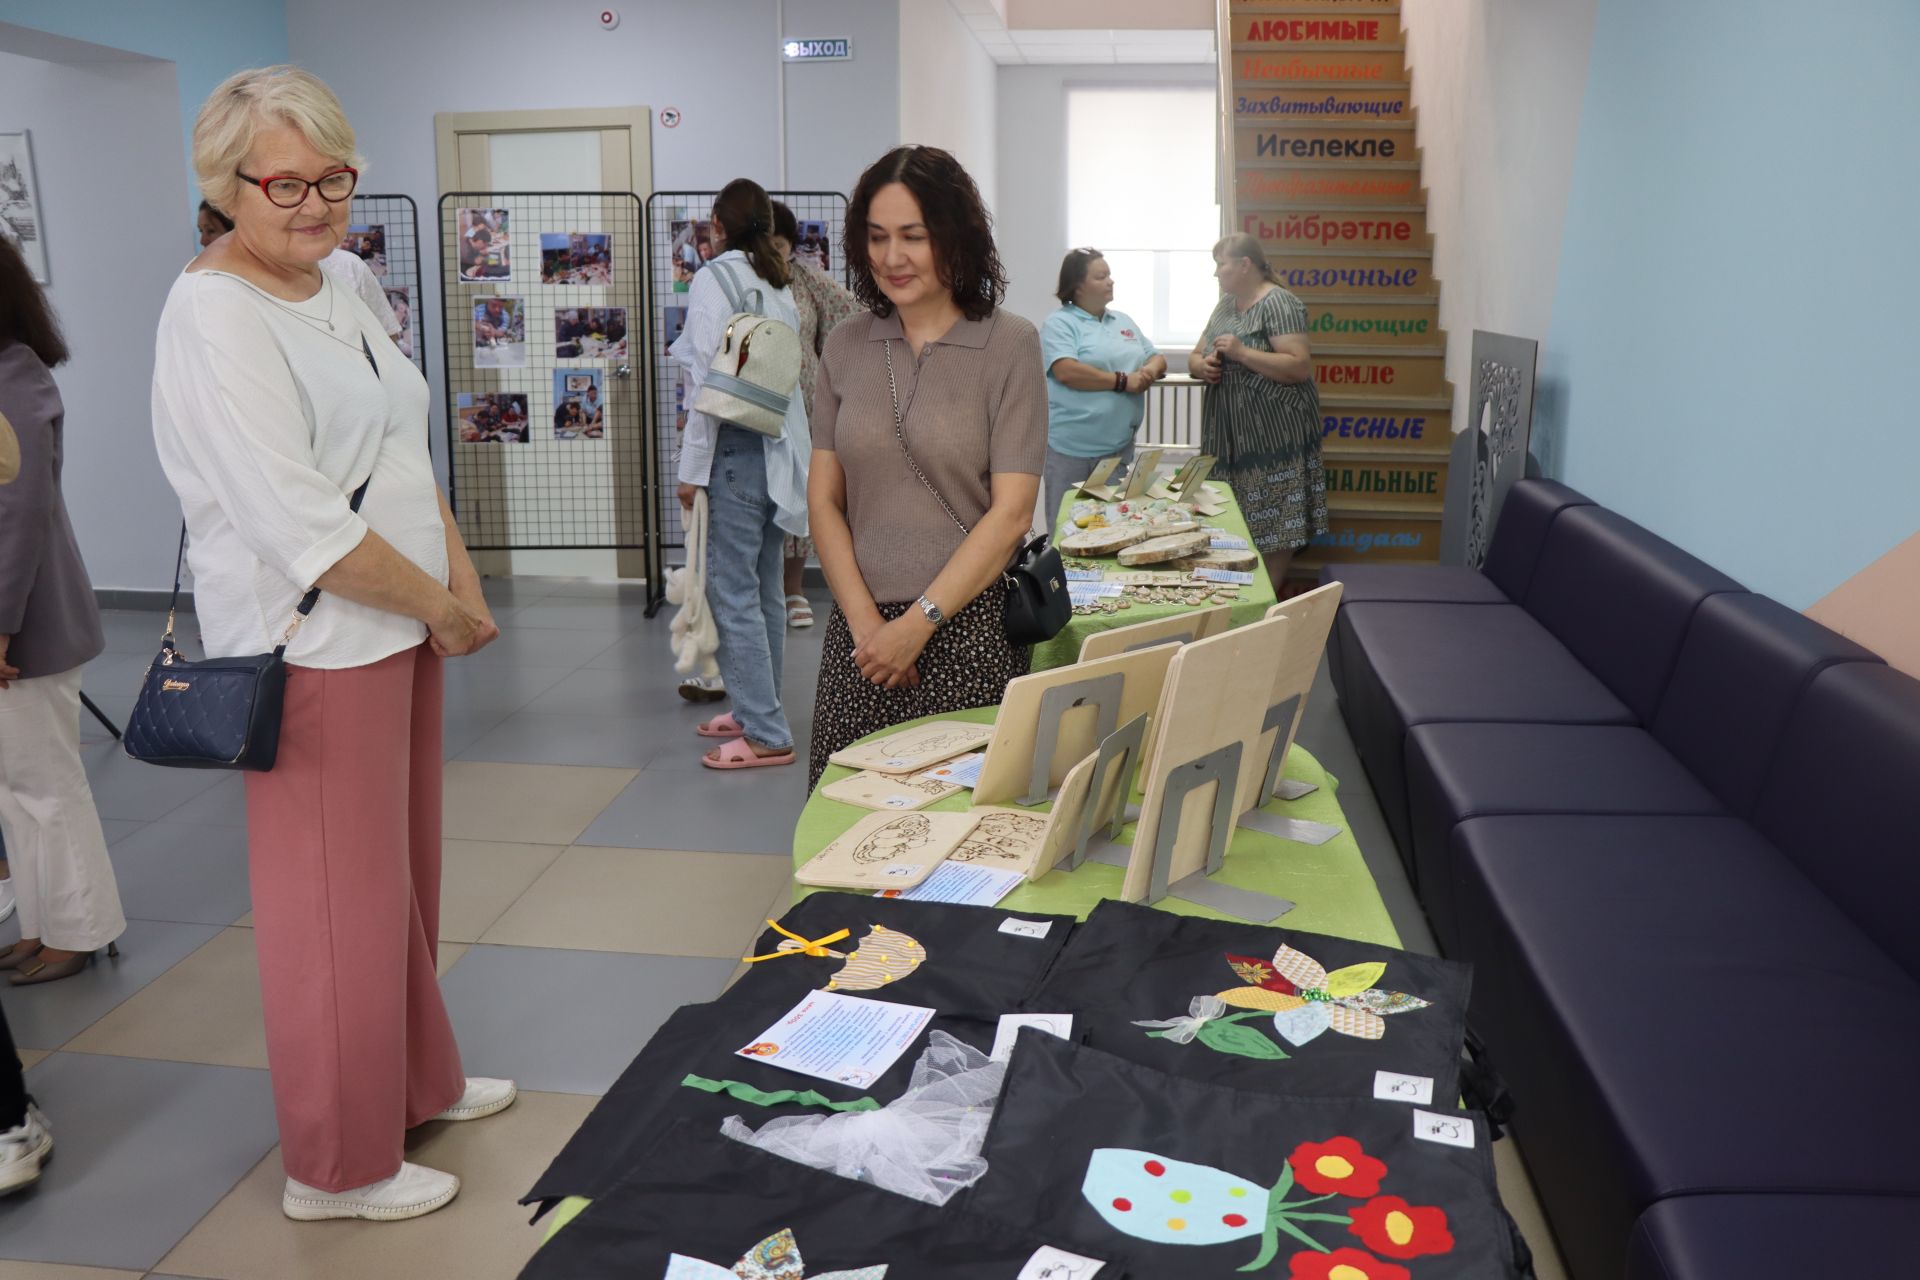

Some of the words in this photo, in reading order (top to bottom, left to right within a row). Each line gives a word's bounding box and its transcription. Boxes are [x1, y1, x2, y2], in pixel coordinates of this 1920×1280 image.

[1248, 20, 1379, 42] ЛЮБИМЫЕ
[790, 41, 846, 57] ВЫХОД
[1243, 57, 1383, 80] Необычные
[1236, 96, 1403, 117] Захватывающие
[1256, 134, 1395, 157] Игелекле
[1244, 214, 1412, 246] Гыйбрәтле
[1281, 267, 1418, 287] азочные
[1247, 486, 1269, 502] OSLO
[1246, 507, 1280, 522] LONDON
[1254, 531, 1279, 547] PARIS
